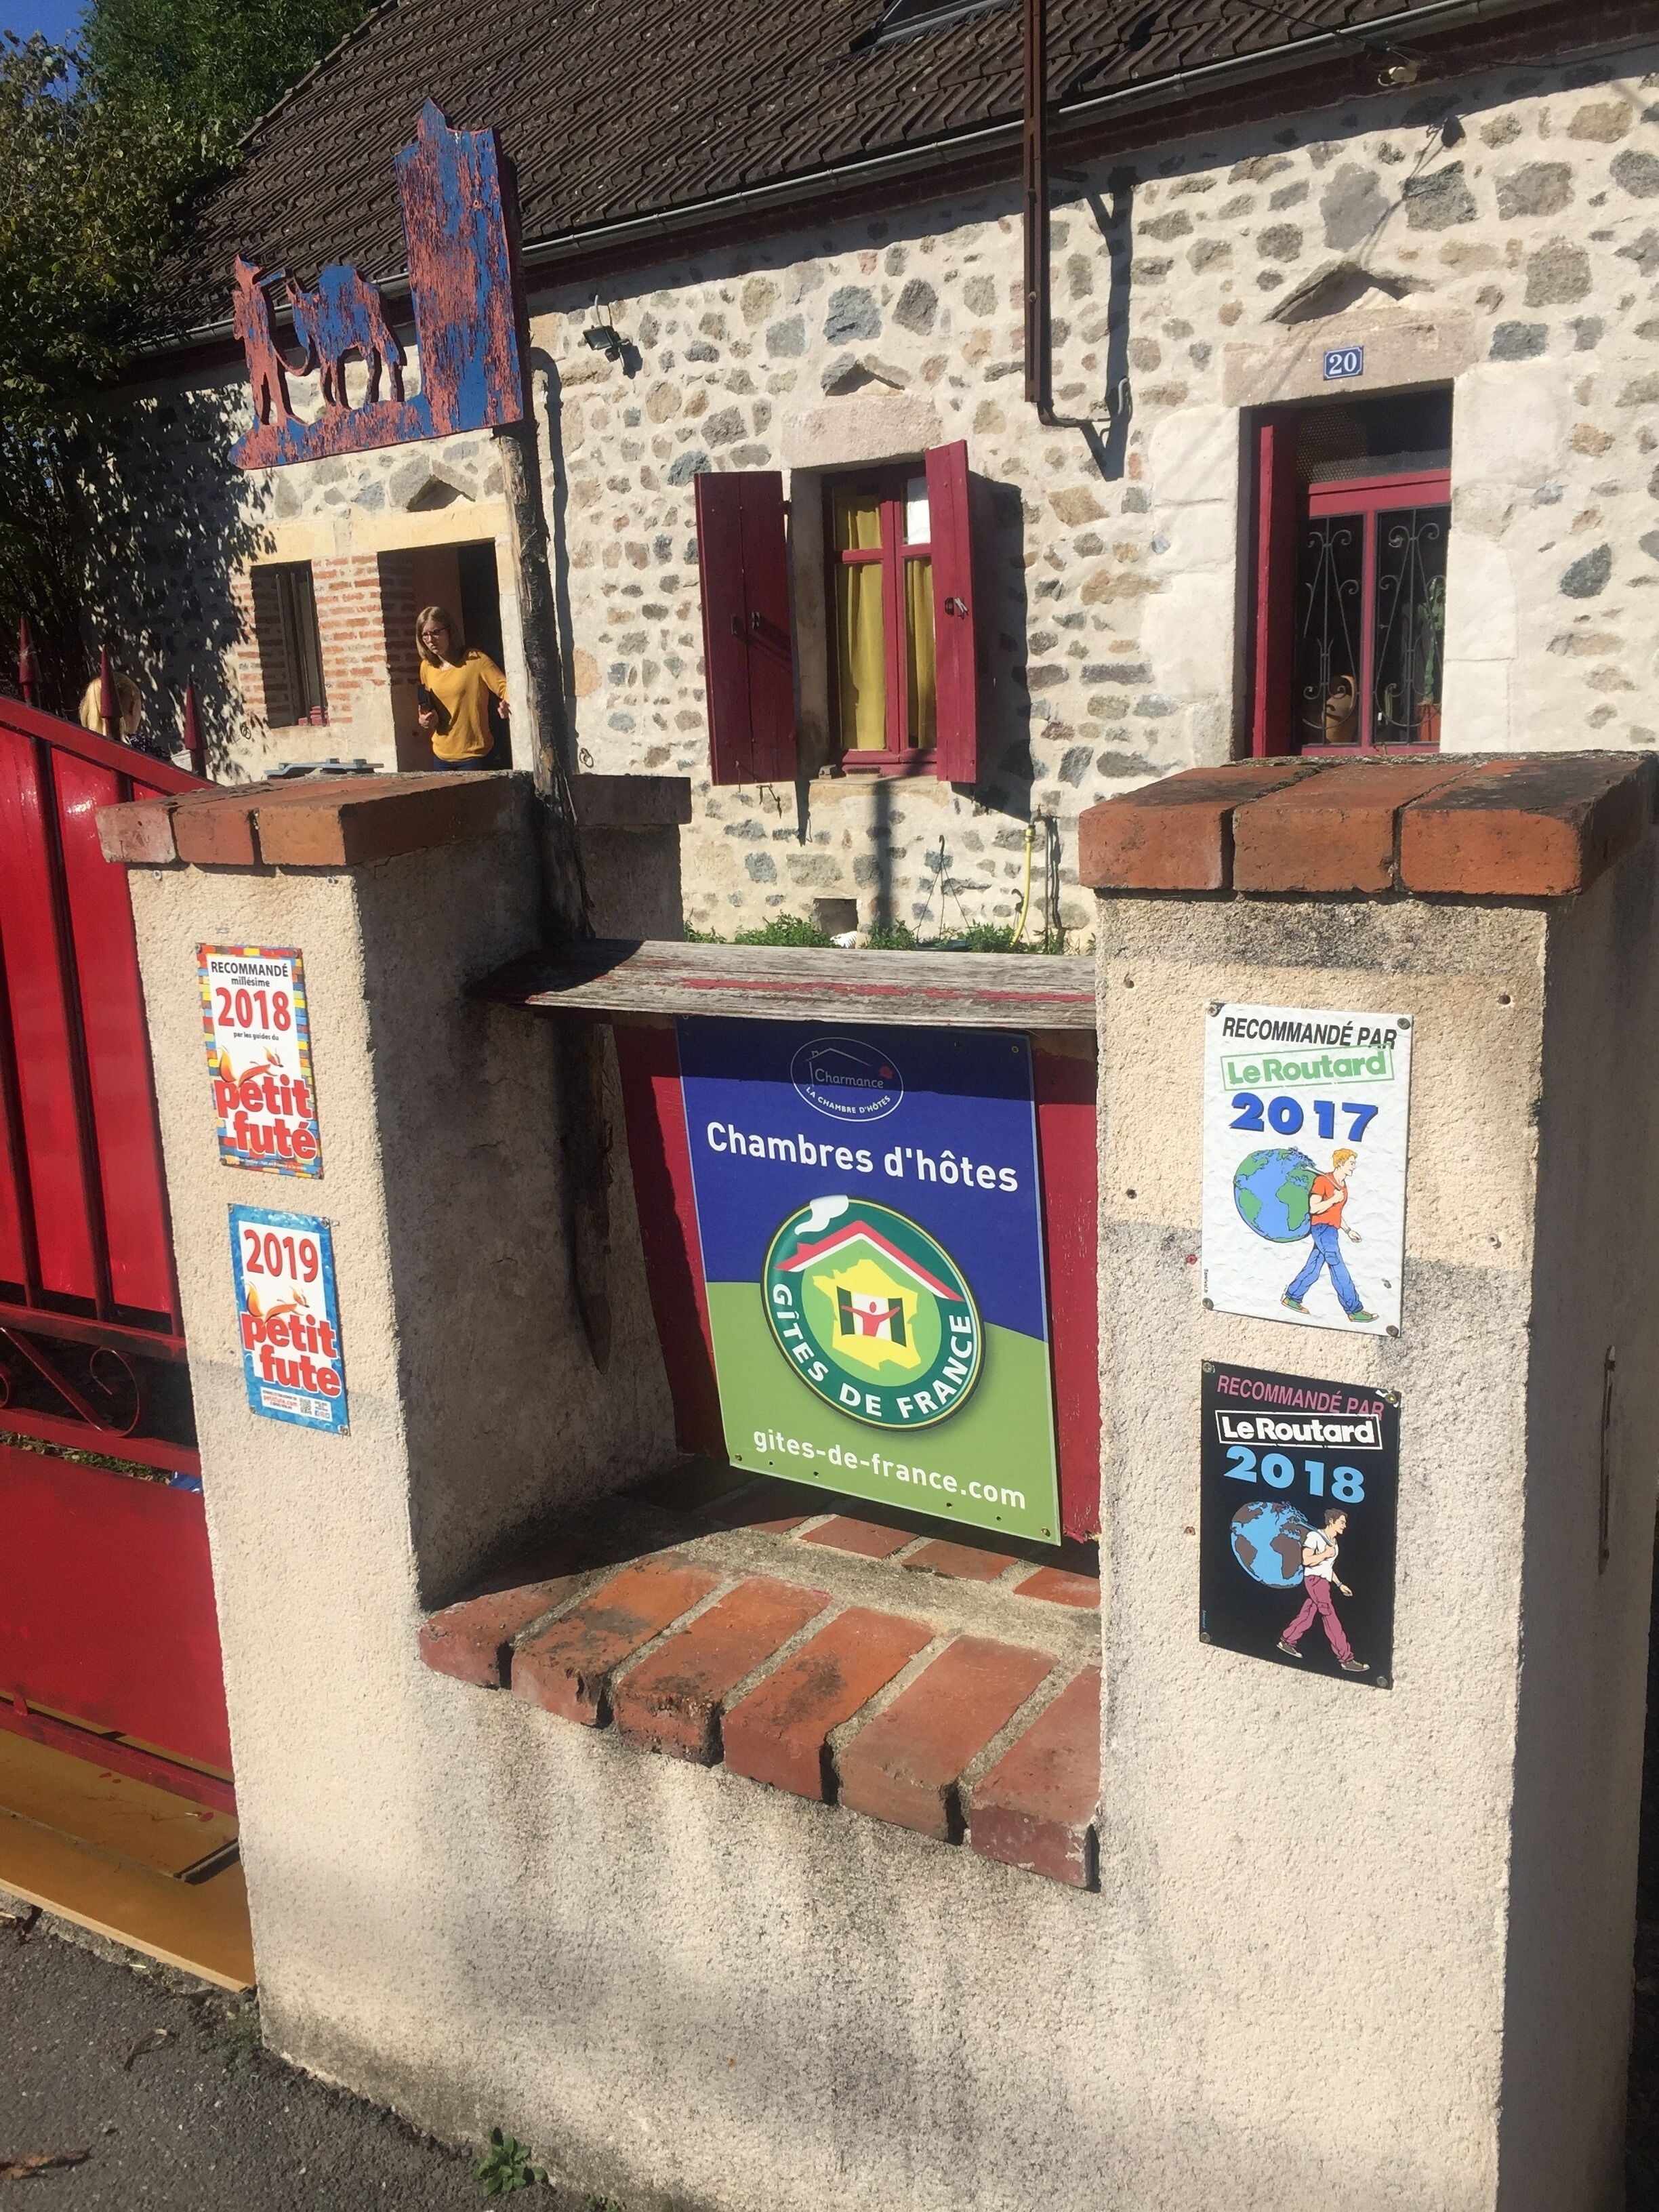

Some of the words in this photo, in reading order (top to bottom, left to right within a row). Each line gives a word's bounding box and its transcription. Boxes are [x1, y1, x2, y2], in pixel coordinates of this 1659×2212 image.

[1329, 352, 1357, 375] 20
[211, 961, 289, 977] RECOMMANDÉ
[231, 976, 270, 987] millésime
[216, 987, 291, 1031] 2018
[233, 1031, 243, 1040] par
[1222, 1017, 1353, 1047] RECOMMANDÉ
[1357, 1026, 1397, 1049] PAR
[214, 1074, 313, 1119] petit
[806, 1086, 817, 1099] LA
[817, 1095, 857, 1114] CHAMBRE
[859, 1094, 891, 1114] D'HÔTES
[815, 1067, 884, 1088] Charmance
[233, 1110, 317, 1160] futé
[1229, 1092, 1379, 1143] 2017
[707, 1122, 874, 1173] Chambres
[884, 1147, 1019, 1192] d'hôtes
[243, 1229, 319, 1283] 2019
[241, 1313, 337, 1359] petit
[773, 1283, 829, 1382] GÎTES
[839, 1382, 882, 1417] DE
[896, 1314, 972, 1418] FRANCE
[260, 1344, 342, 1397] fute
[1216, 1375, 1341, 1414] RECOMMANDÉ
[1346, 1397, 1385, 1420] PAR
[753, 1428, 1026, 1510] gites-de-france.com
[1223, 1446, 1366, 1504] 2018
